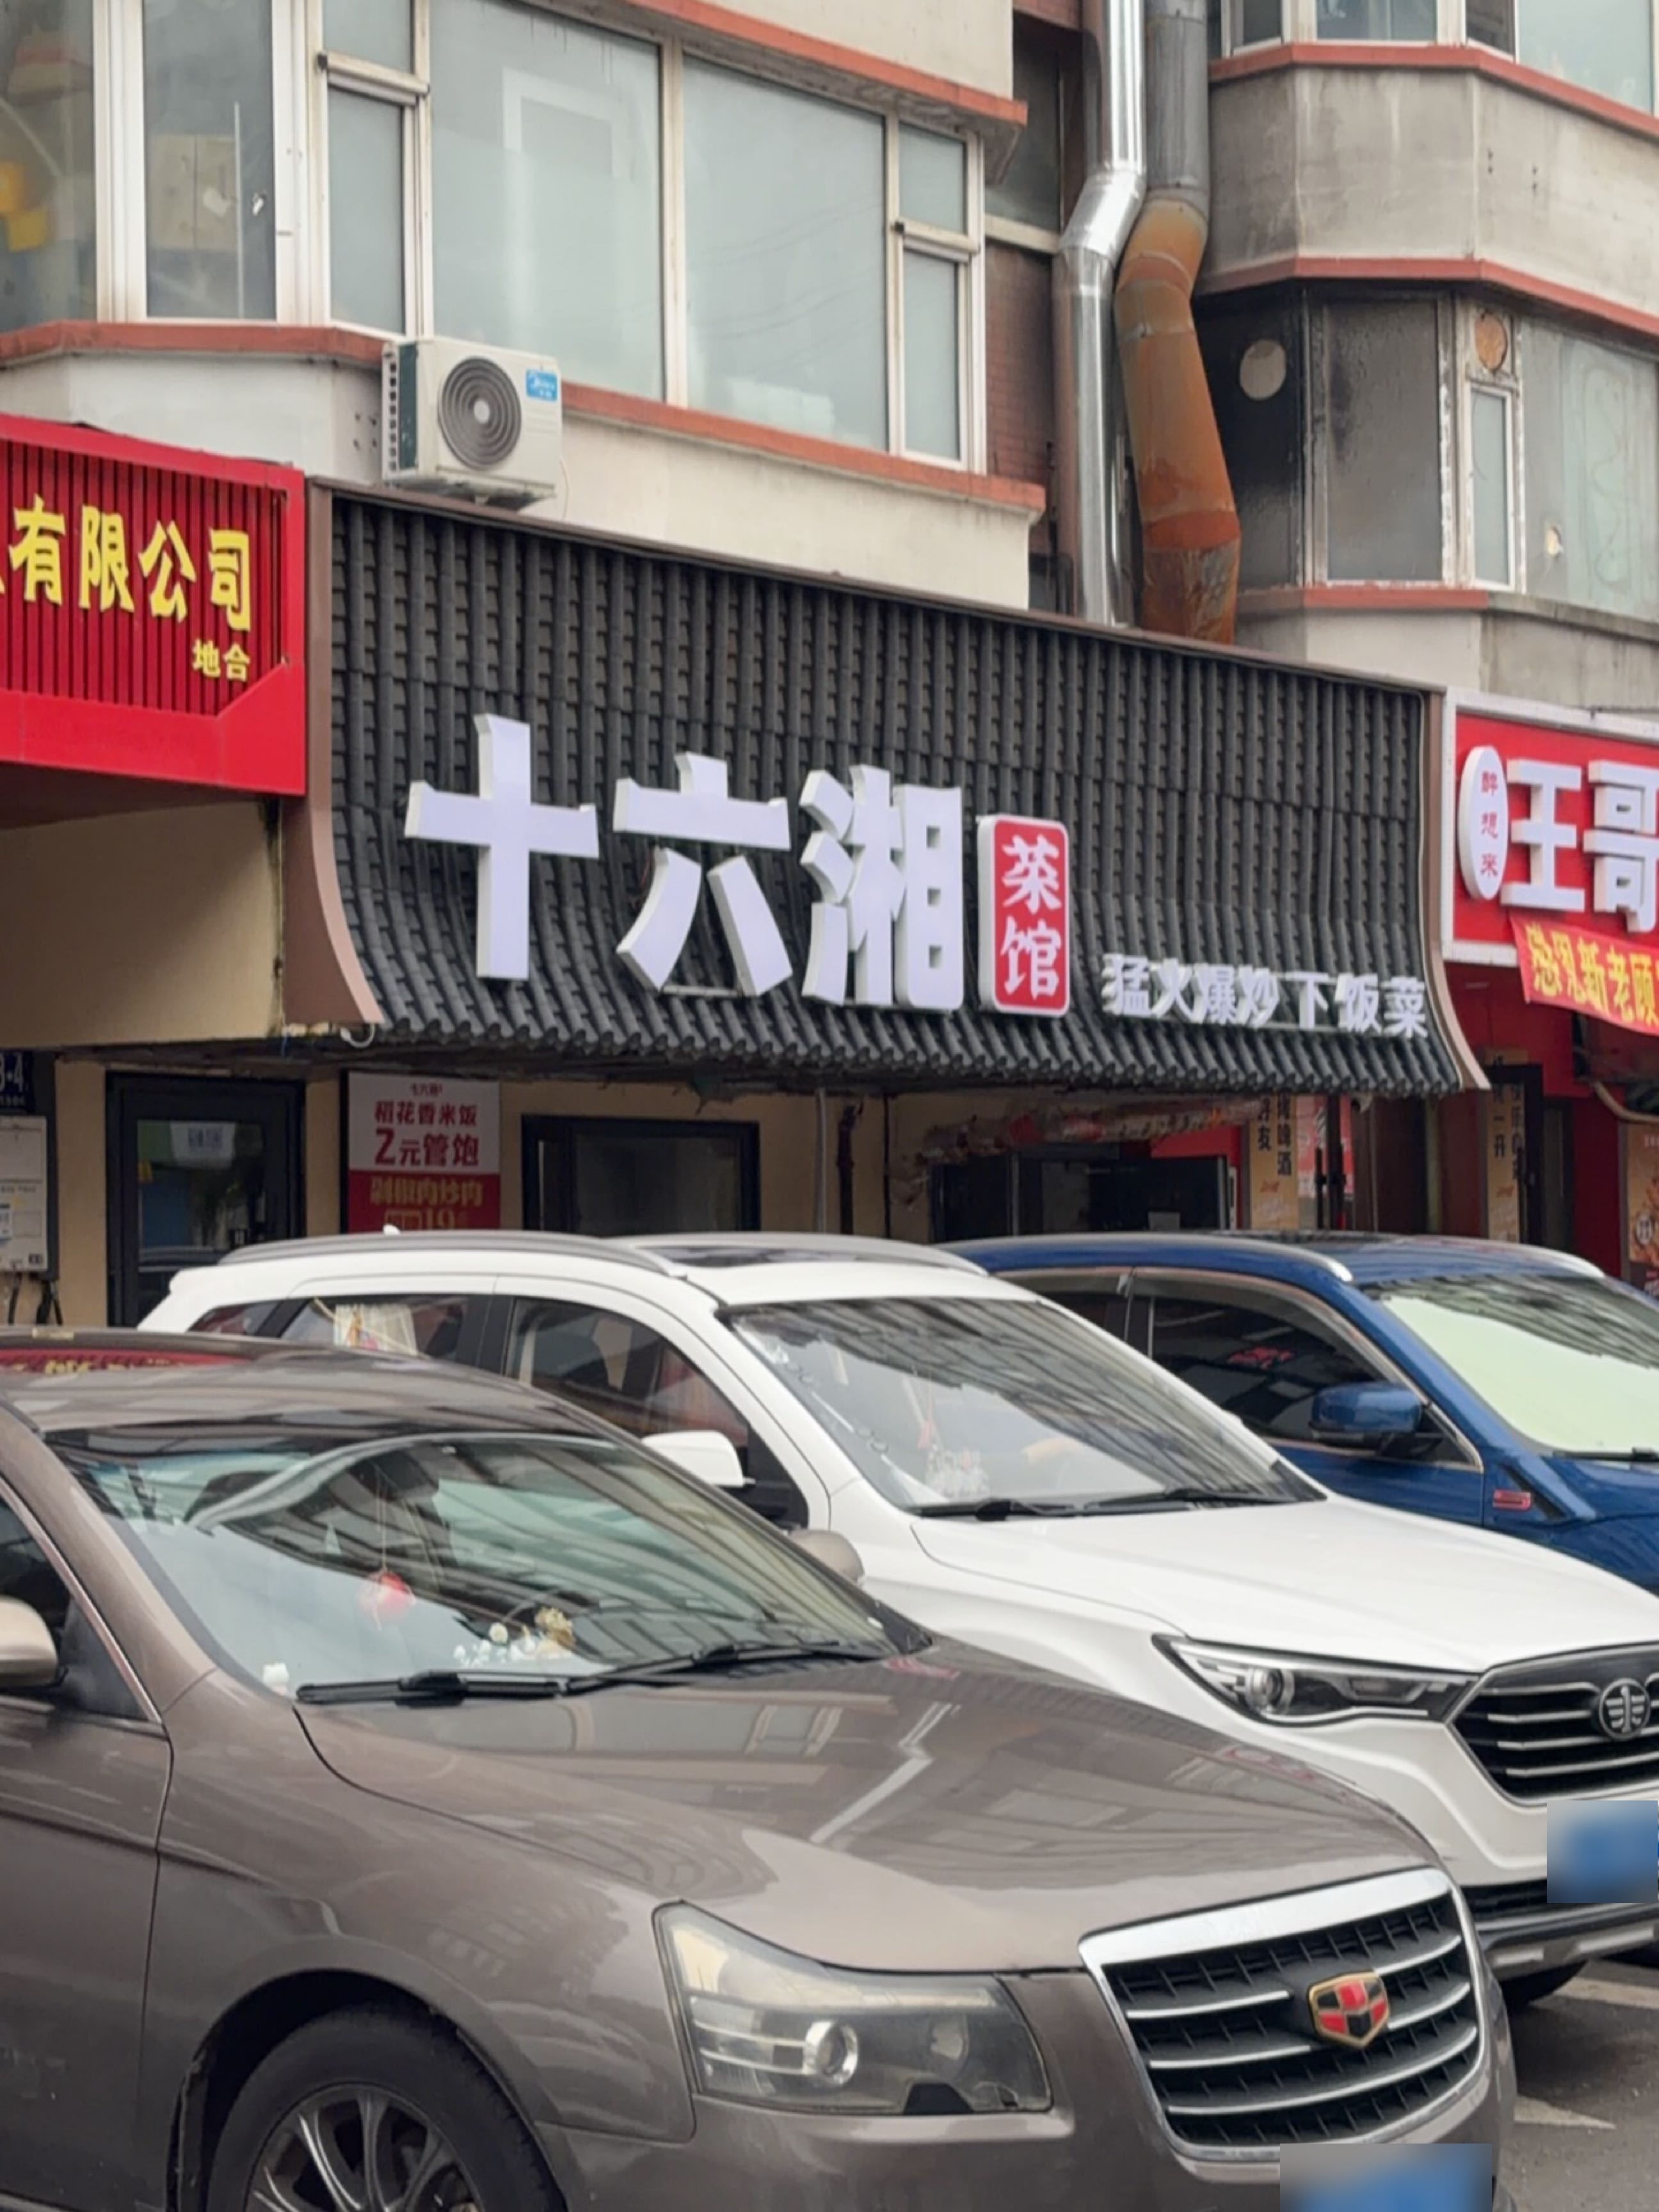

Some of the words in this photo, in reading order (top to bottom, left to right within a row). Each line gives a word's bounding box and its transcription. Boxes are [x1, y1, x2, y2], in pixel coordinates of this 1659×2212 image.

[0, 493, 252, 632] 有限公司
[404, 712, 964, 1011] 十六湘
[1500, 758, 1659, 933] 王哥
[1000, 833, 1063, 1001] 菜馆
[1525, 920, 1659, 1029] 感恩新老顾
[1101, 953, 1429, 1039] 猛火爆炒下饭菜
[374, 1127, 479, 1167] 2元管饱
